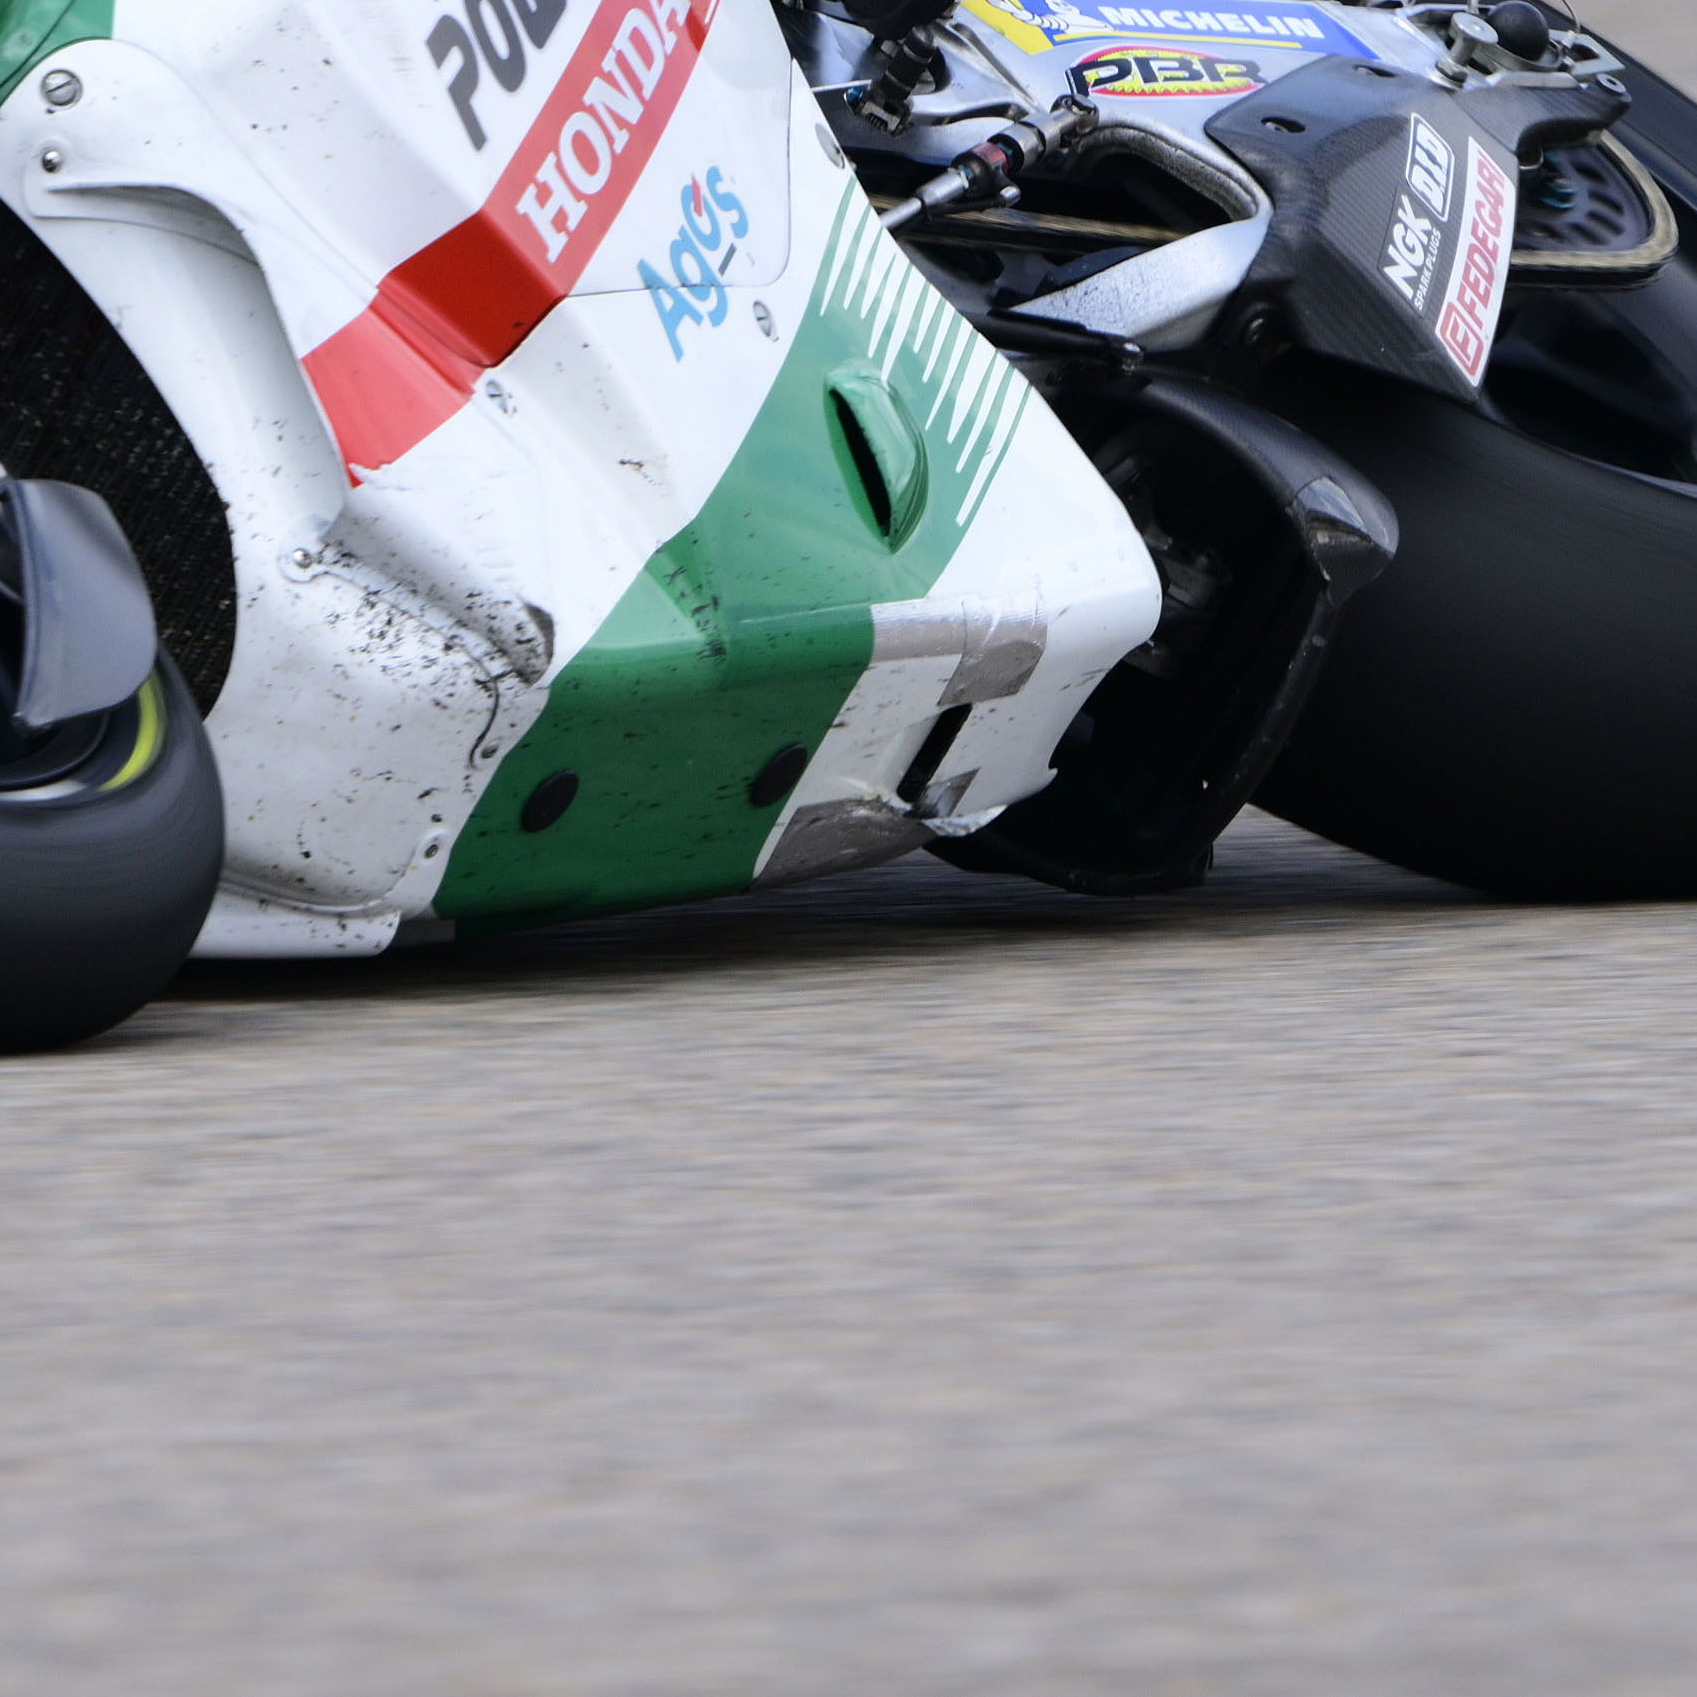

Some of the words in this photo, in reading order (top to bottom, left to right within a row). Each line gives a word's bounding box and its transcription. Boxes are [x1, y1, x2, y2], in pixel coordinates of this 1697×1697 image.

[1096, 6, 1325, 39] MICHELIN
[1064, 57, 1269, 98] PBR
[1384, 195, 1433, 300] NGK
[1414, 266, 1435, 311] SPARK
[1425, 227, 1443, 270] PLUGS
[1456, 149, 1509, 331] FEDEGARI
